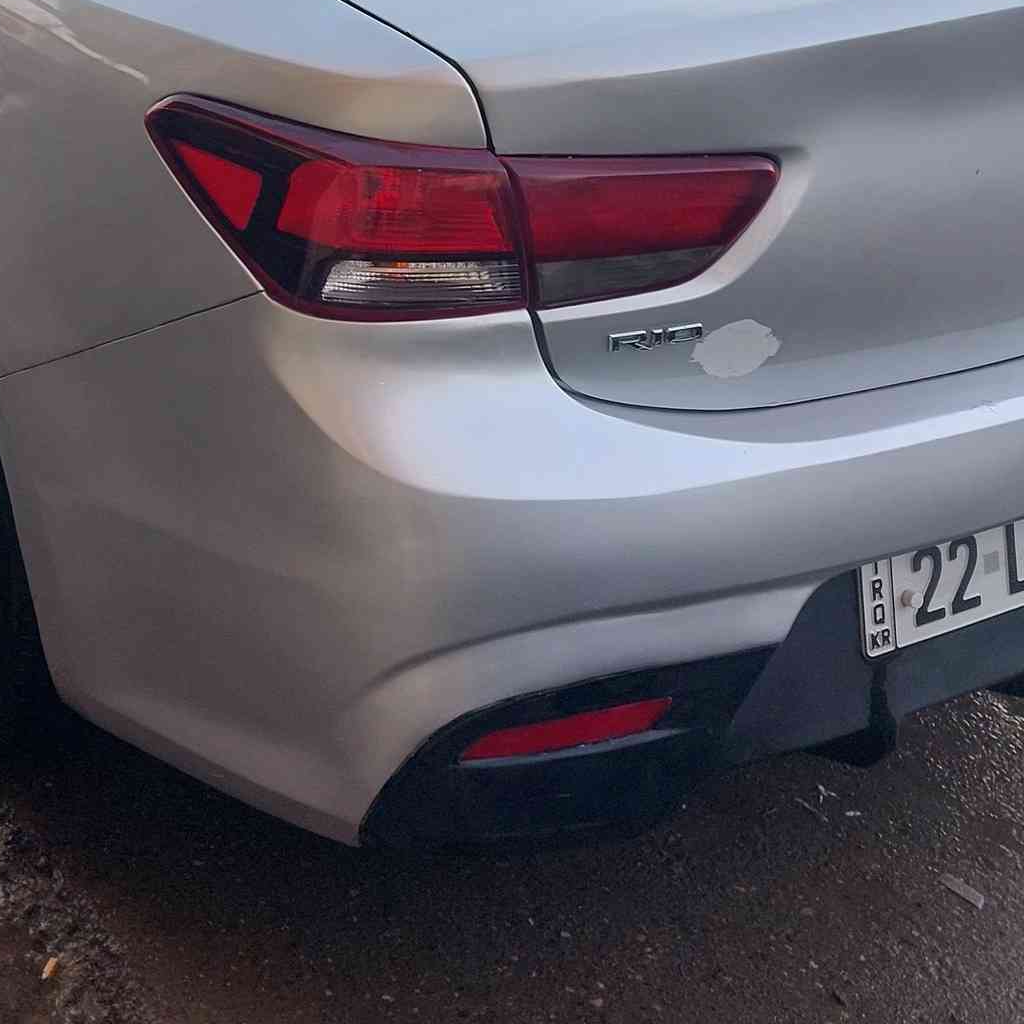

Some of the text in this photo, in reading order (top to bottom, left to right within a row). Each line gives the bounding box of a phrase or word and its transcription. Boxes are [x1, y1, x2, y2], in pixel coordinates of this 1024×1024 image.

[608, 322, 704, 352] RIO
[912, 535, 982, 626] 22
[870, 628, 891, 650] KR
